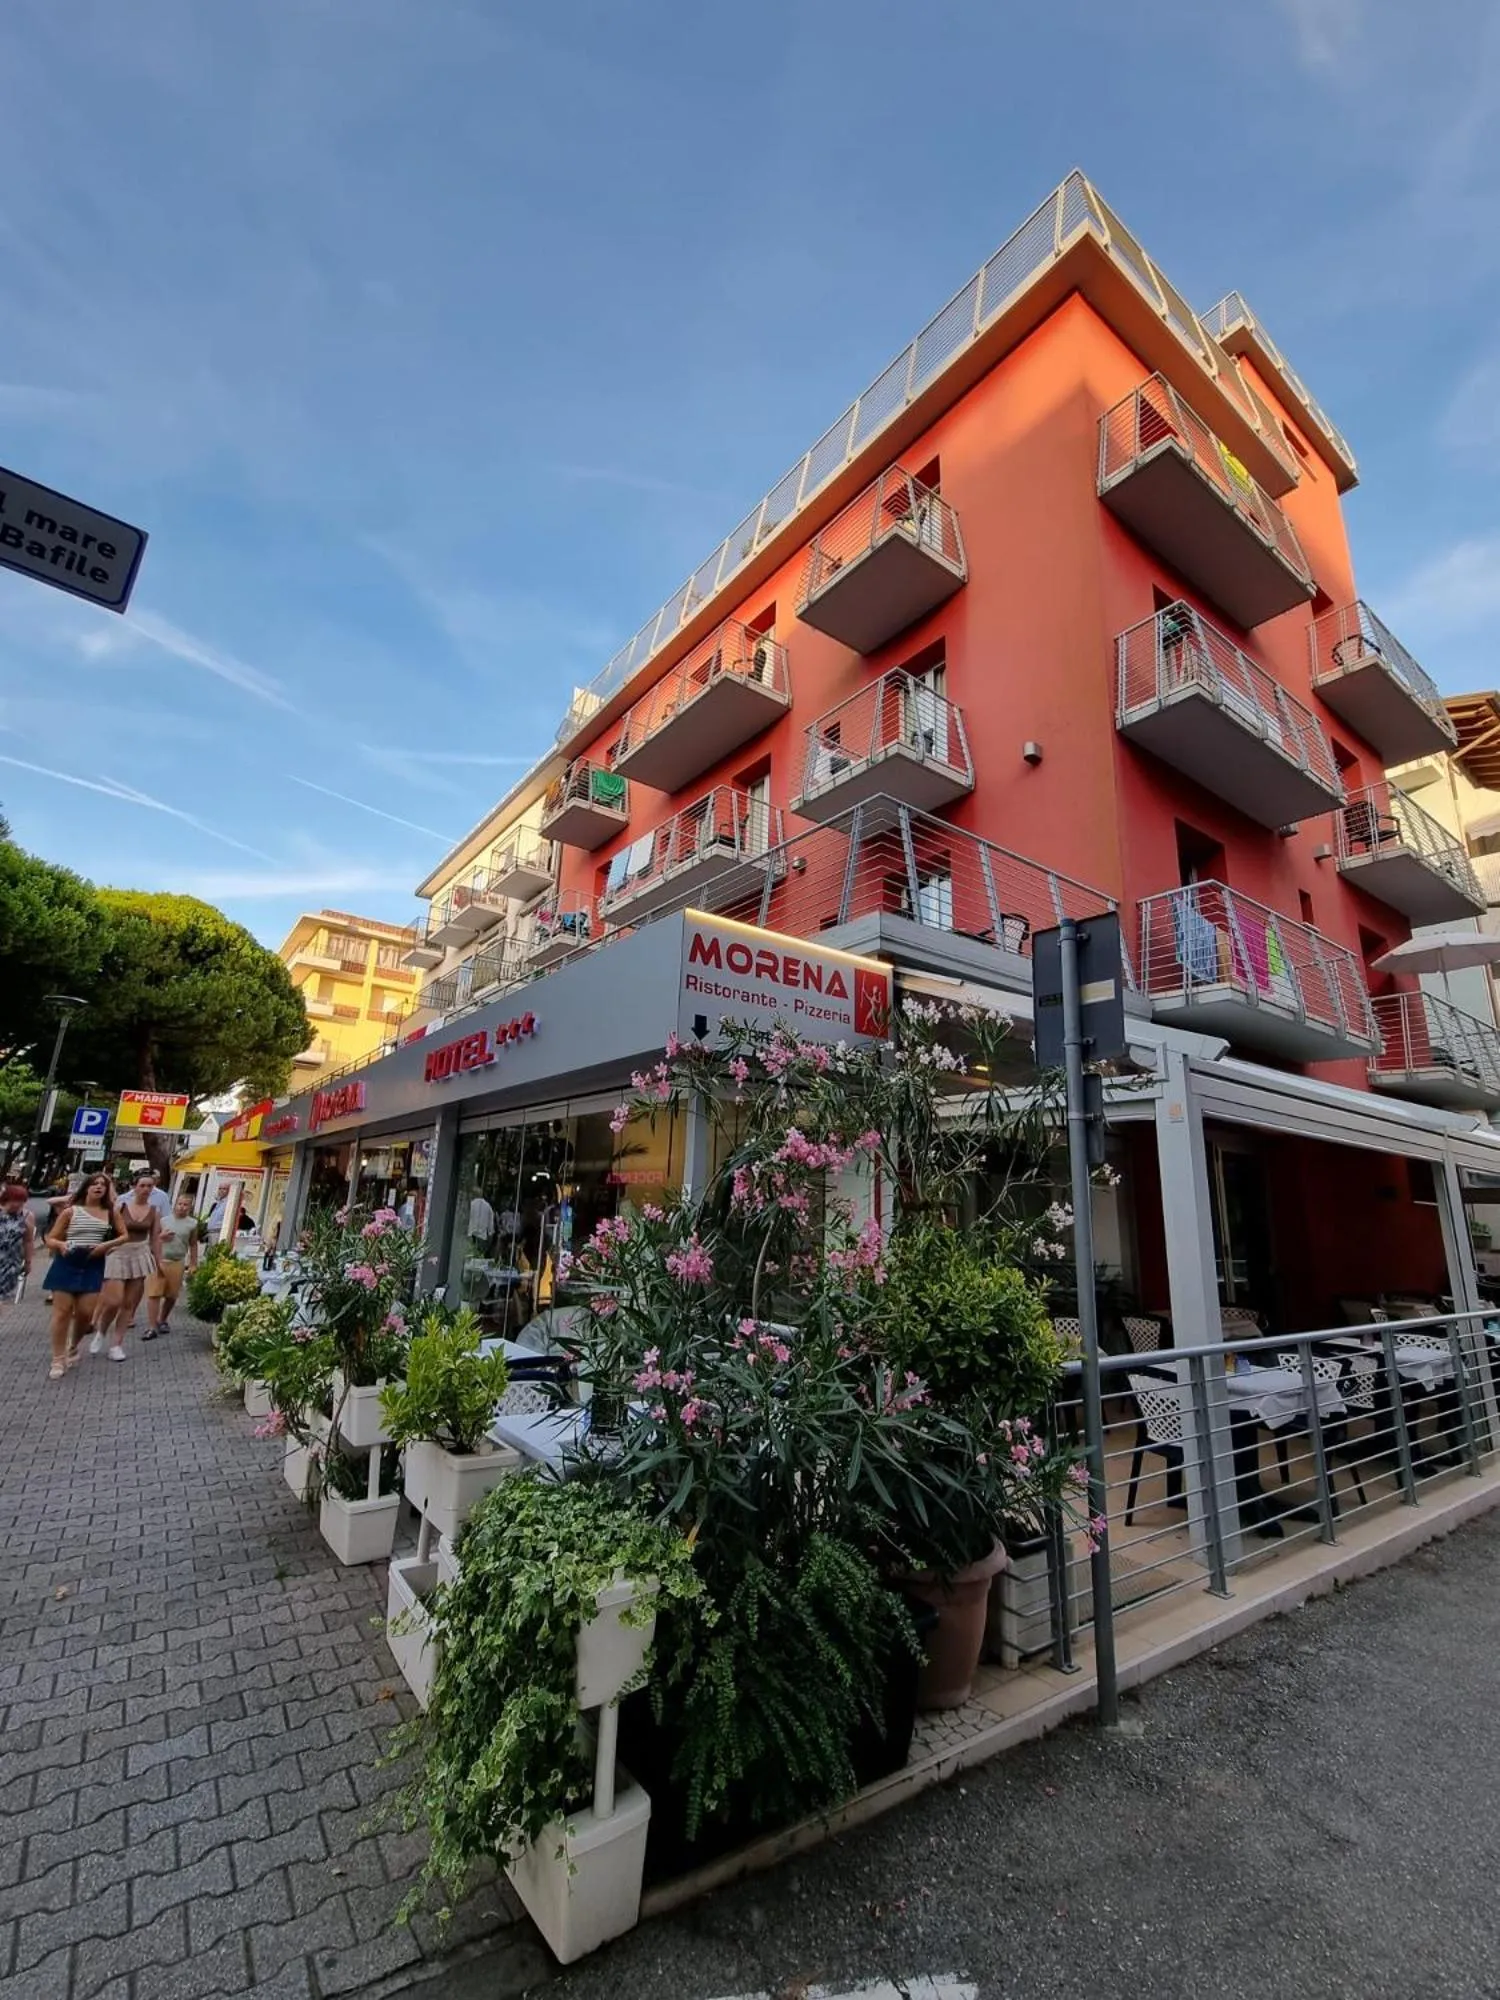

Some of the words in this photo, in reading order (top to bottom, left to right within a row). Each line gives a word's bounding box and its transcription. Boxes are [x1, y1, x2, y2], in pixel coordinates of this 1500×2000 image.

[0, 522, 110, 584] Bafile
[24, 509, 118, 560] mare
[688, 932, 849, 999] MORENA
[685, 974, 778, 1009] Ristorante
[794, 999, 851, 1025] Pizzeria
[424, 1031, 495, 1083] HOTEL
[79, 1110, 102, 1132] P
[134, 1094, 178, 1105] MARKET
